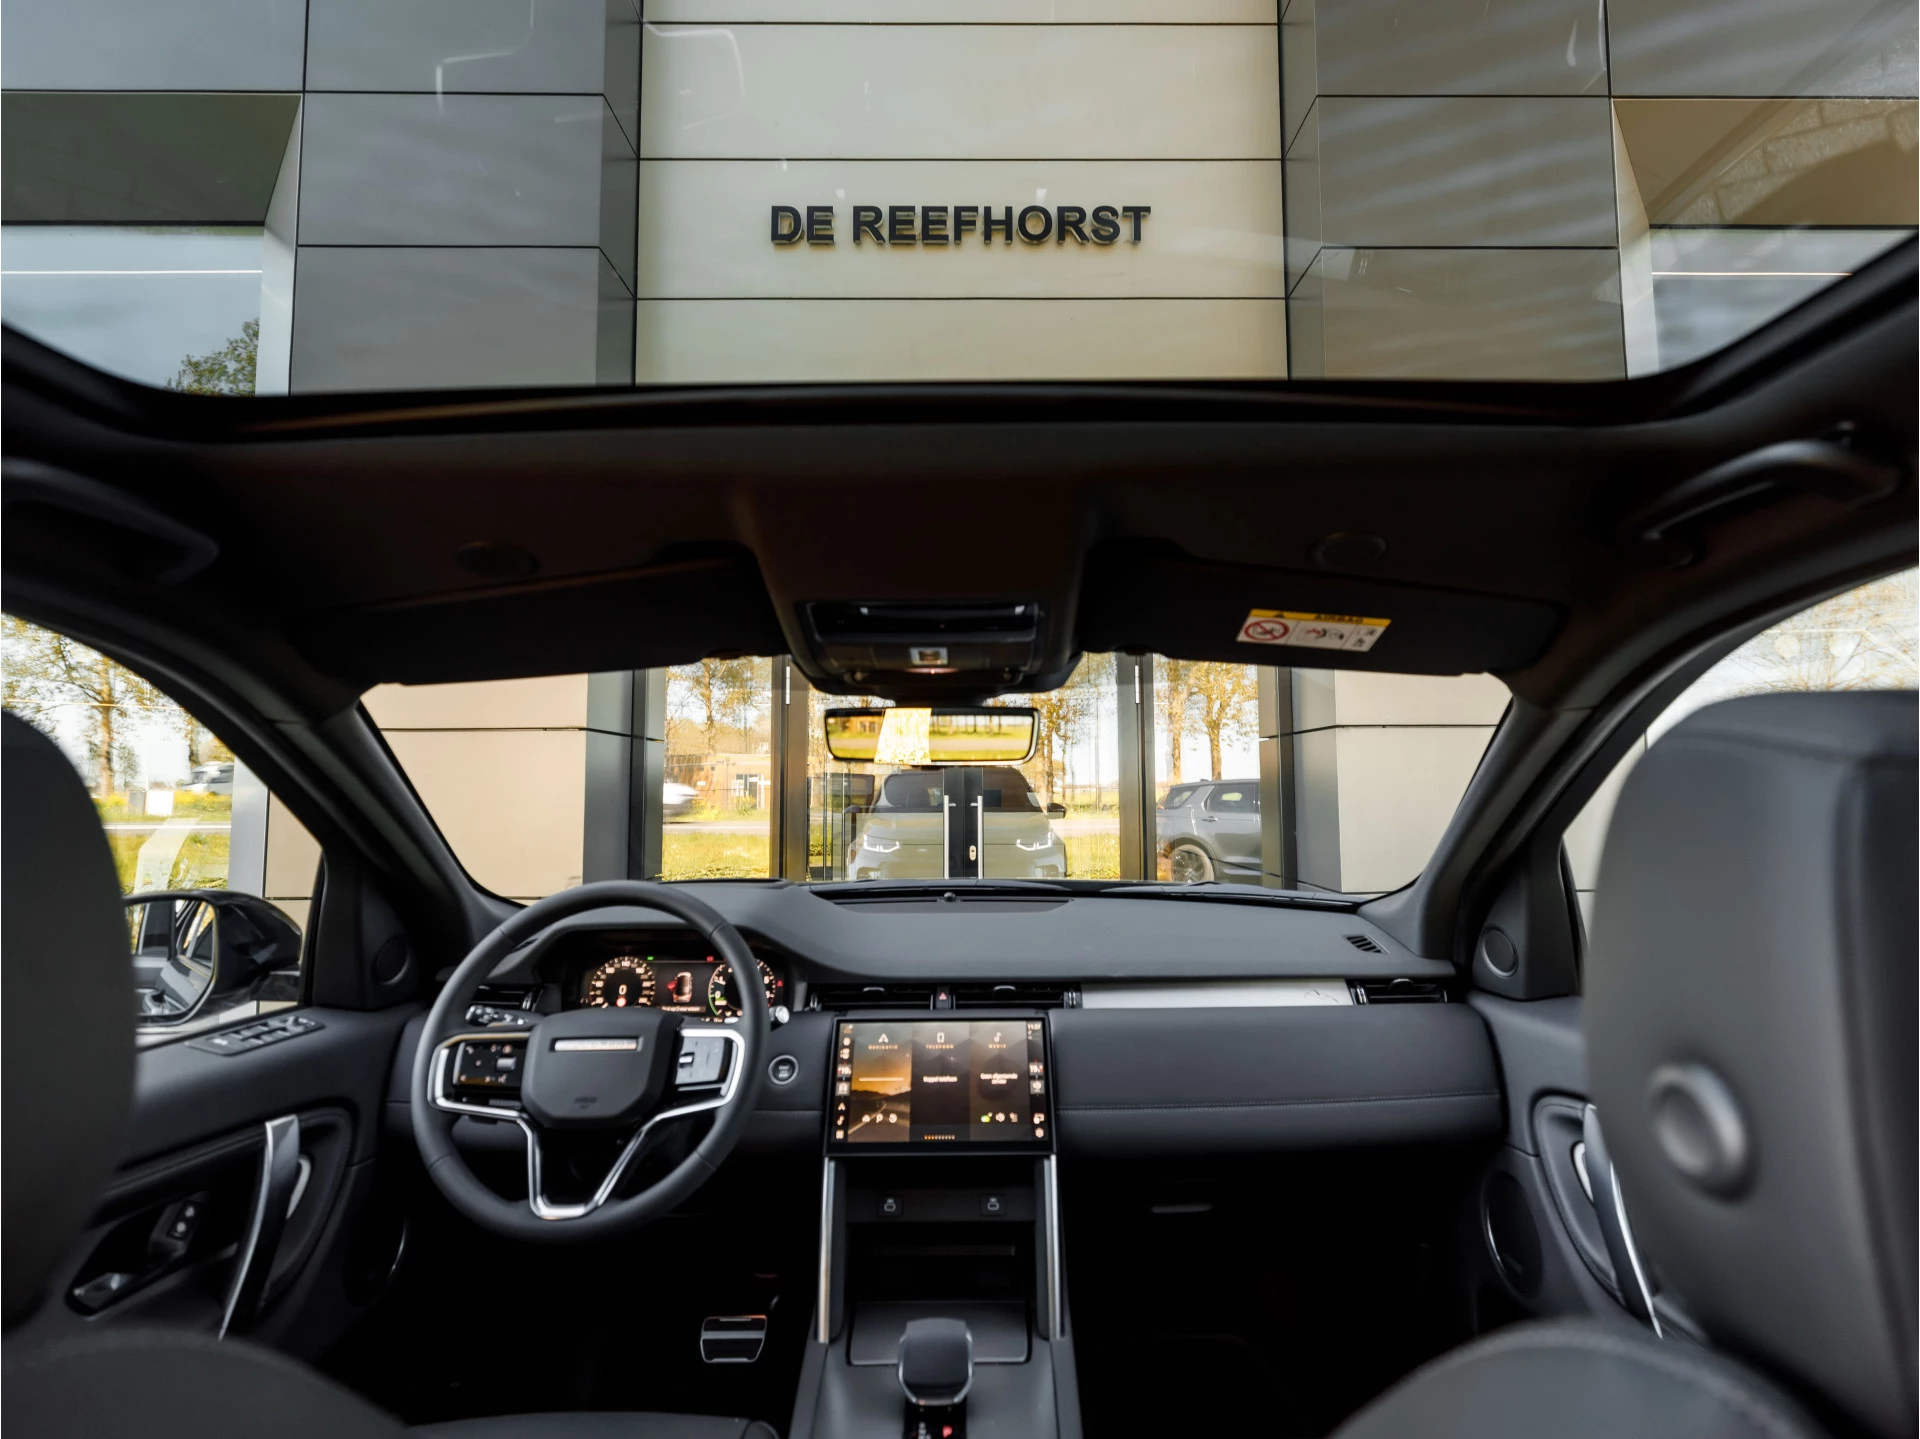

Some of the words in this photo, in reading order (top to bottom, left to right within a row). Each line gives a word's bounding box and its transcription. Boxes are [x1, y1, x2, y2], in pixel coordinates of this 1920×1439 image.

[770, 205, 834, 244] DE
[852, 205, 1152, 244] REEFHORST
[1314, 613, 1363, 624] AIRBAG
